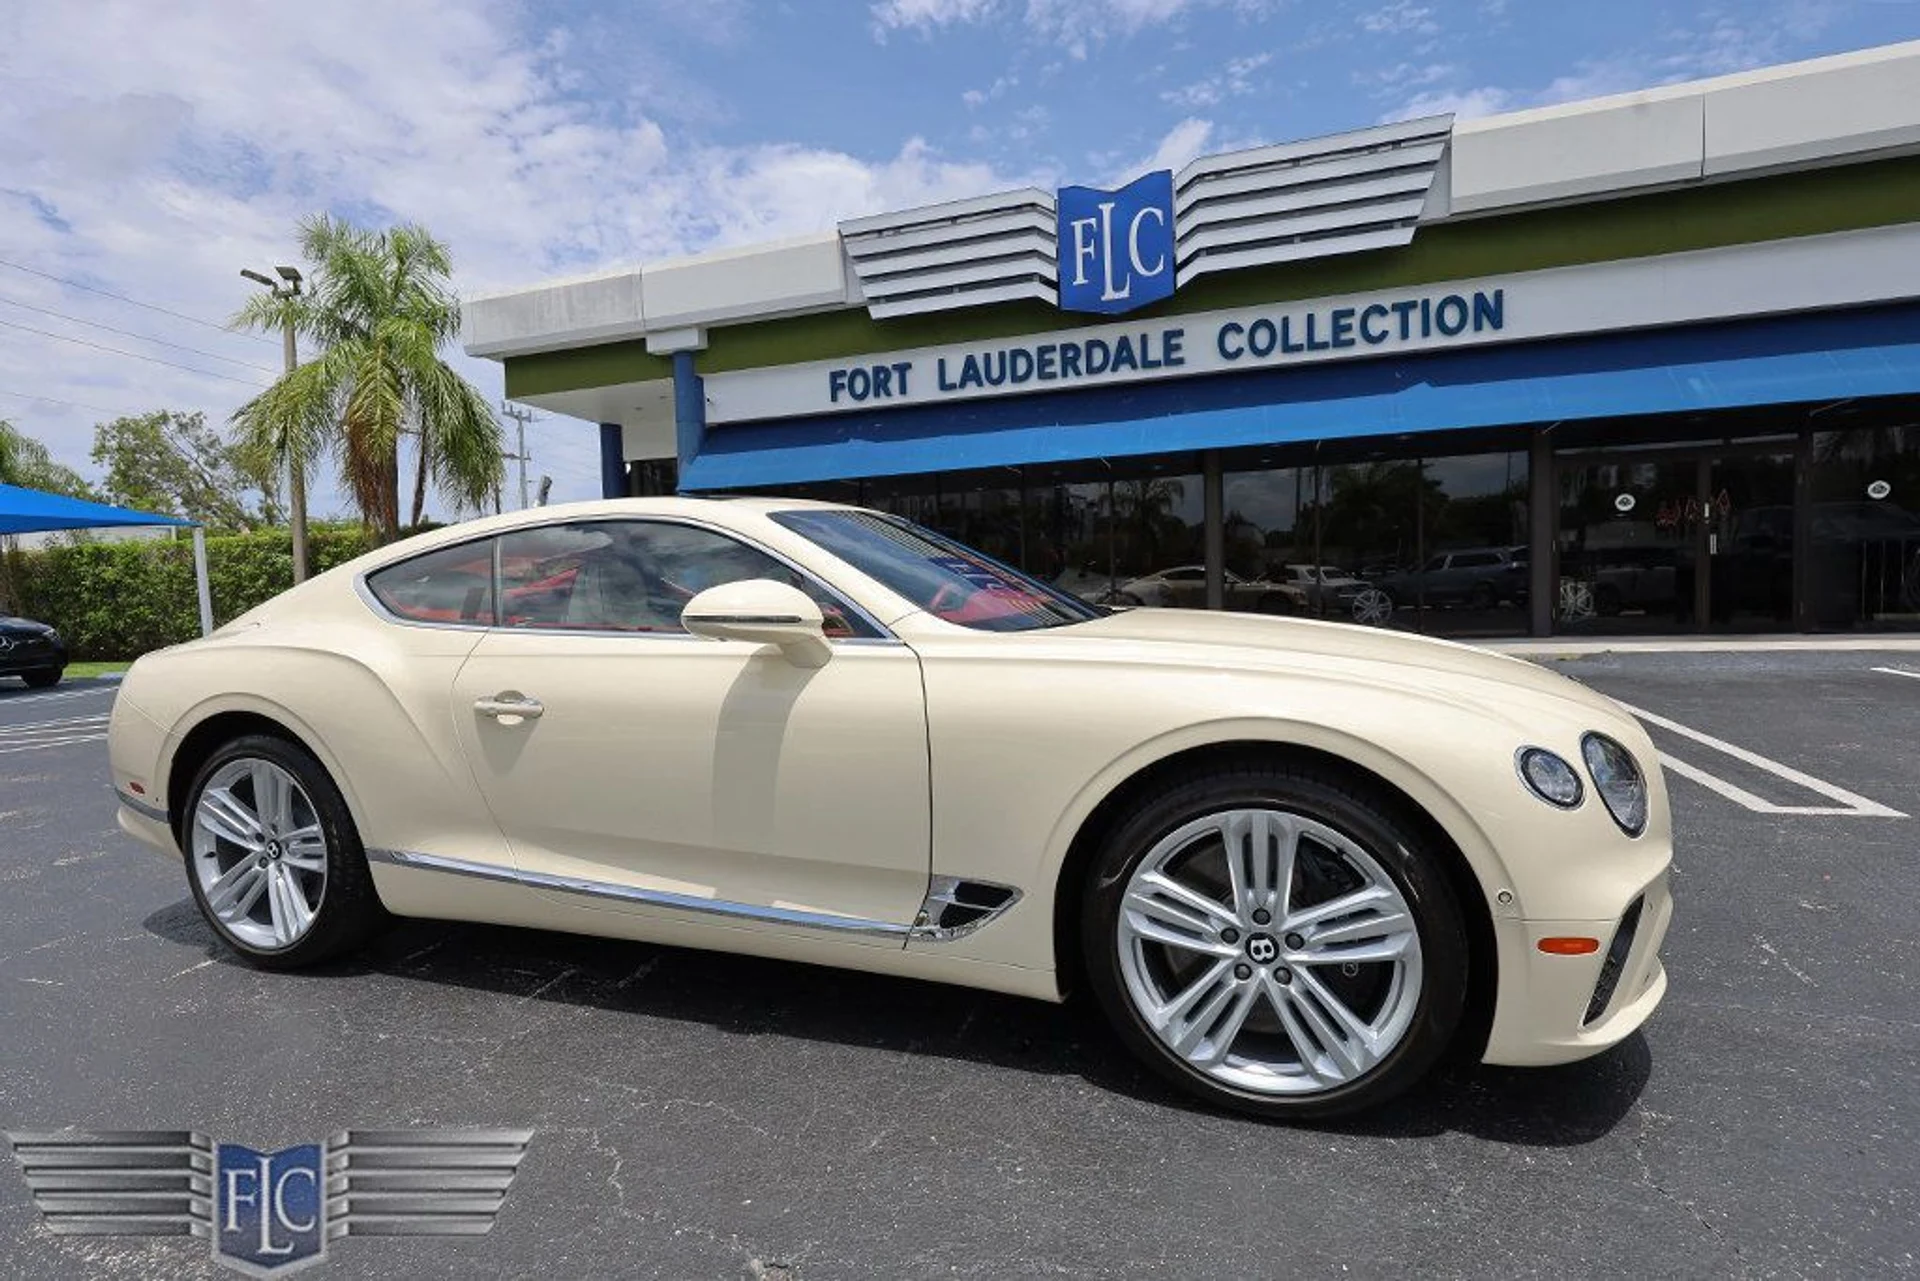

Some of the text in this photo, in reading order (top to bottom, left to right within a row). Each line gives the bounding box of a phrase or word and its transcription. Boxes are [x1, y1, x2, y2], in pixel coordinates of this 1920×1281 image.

[1071, 202, 1165, 301] FLC
[829, 290, 1504, 402] FORT LAUDERDALE COLLECTION
[1250, 938, 1275, 961] B
